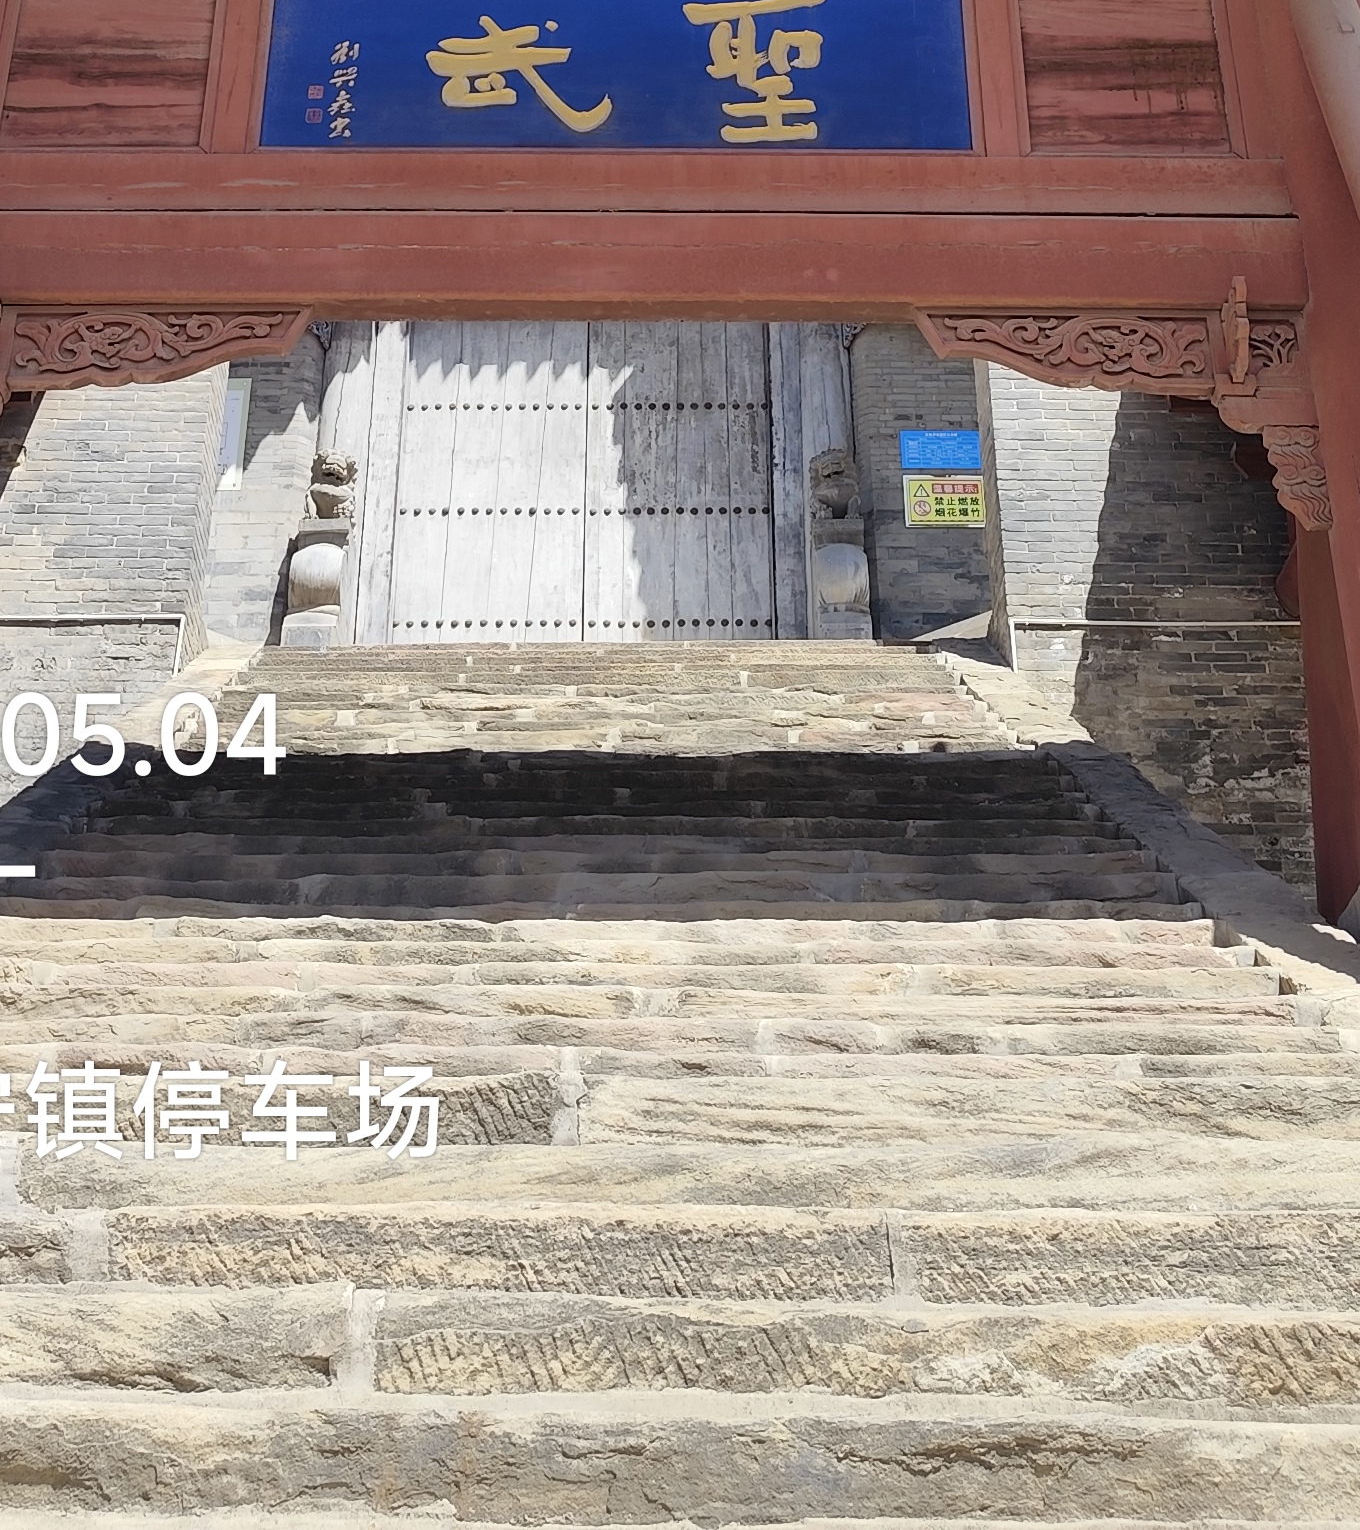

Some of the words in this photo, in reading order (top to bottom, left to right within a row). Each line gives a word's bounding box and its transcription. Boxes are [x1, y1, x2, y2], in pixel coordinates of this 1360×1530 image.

[934, 496, 980, 506] 禁止燃放
[934, 507, 981, 518] 烟花爆竹
